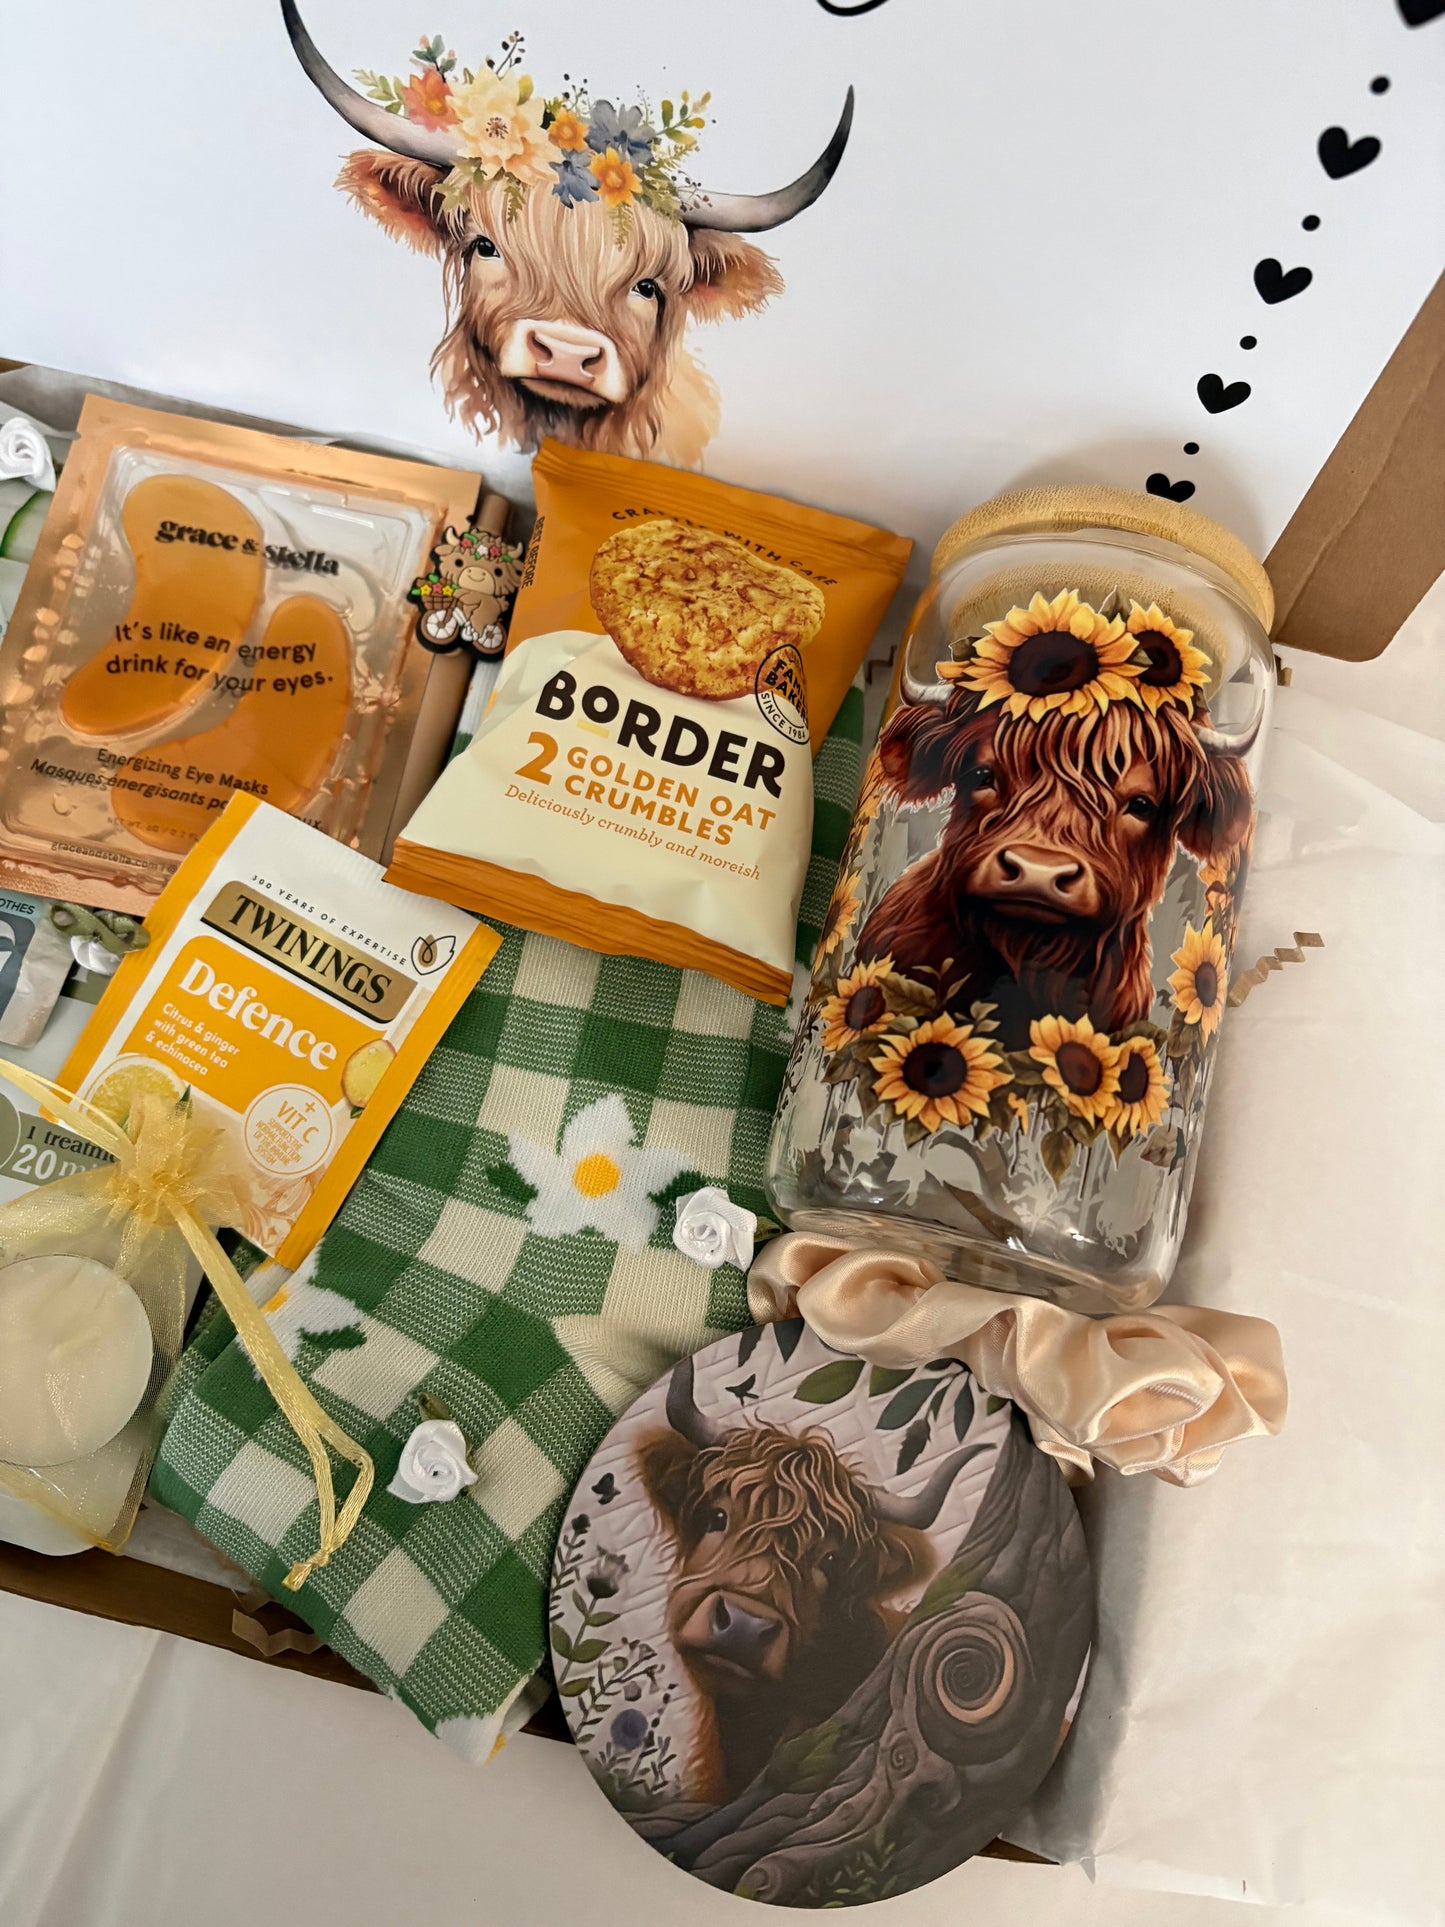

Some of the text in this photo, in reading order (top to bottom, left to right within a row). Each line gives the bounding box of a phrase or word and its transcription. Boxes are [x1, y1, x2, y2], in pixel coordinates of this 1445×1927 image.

[155, 520, 339, 576] grace & stella
[521, 544, 541, 590] BEFORE
[790, 560, 837, 585] CARE
[159, 622, 199, 645] like
[204, 635, 231, 653] an
[238, 642, 316, 664] energy
[106, 655, 333, 695] drink for your eyes.
[765, 671, 808, 725] BAKER
[535, 670, 786, 800] BORDER
[761, 692, 786, 728] SINCE
[31, 759, 104, 785] Masques
[97, 749, 269, 795] Energizing Eye Masks
[514, 731, 559, 786] 2
[564, 774, 734, 846] CRUMBLES
[567, 746, 777, 831] GOLDEN OAT
[504, 784, 761, 881] Deliciously crumbly and moreish
[252, 875, 408, 966] 300 YEARS OF EXPERTISE
[229, 894, 392, 1004] TWININGS
[162, 1003, 241, 1056] Citrus & ginger
[179, 958, 337, 1070] Defence
[144, 1030, 209, 1076] & echinacea
[154, 1019, 229, 1069] with green tea
[277, 1100, 319, 1143] VIT C
[12, 1143, 57, 1180] 20
